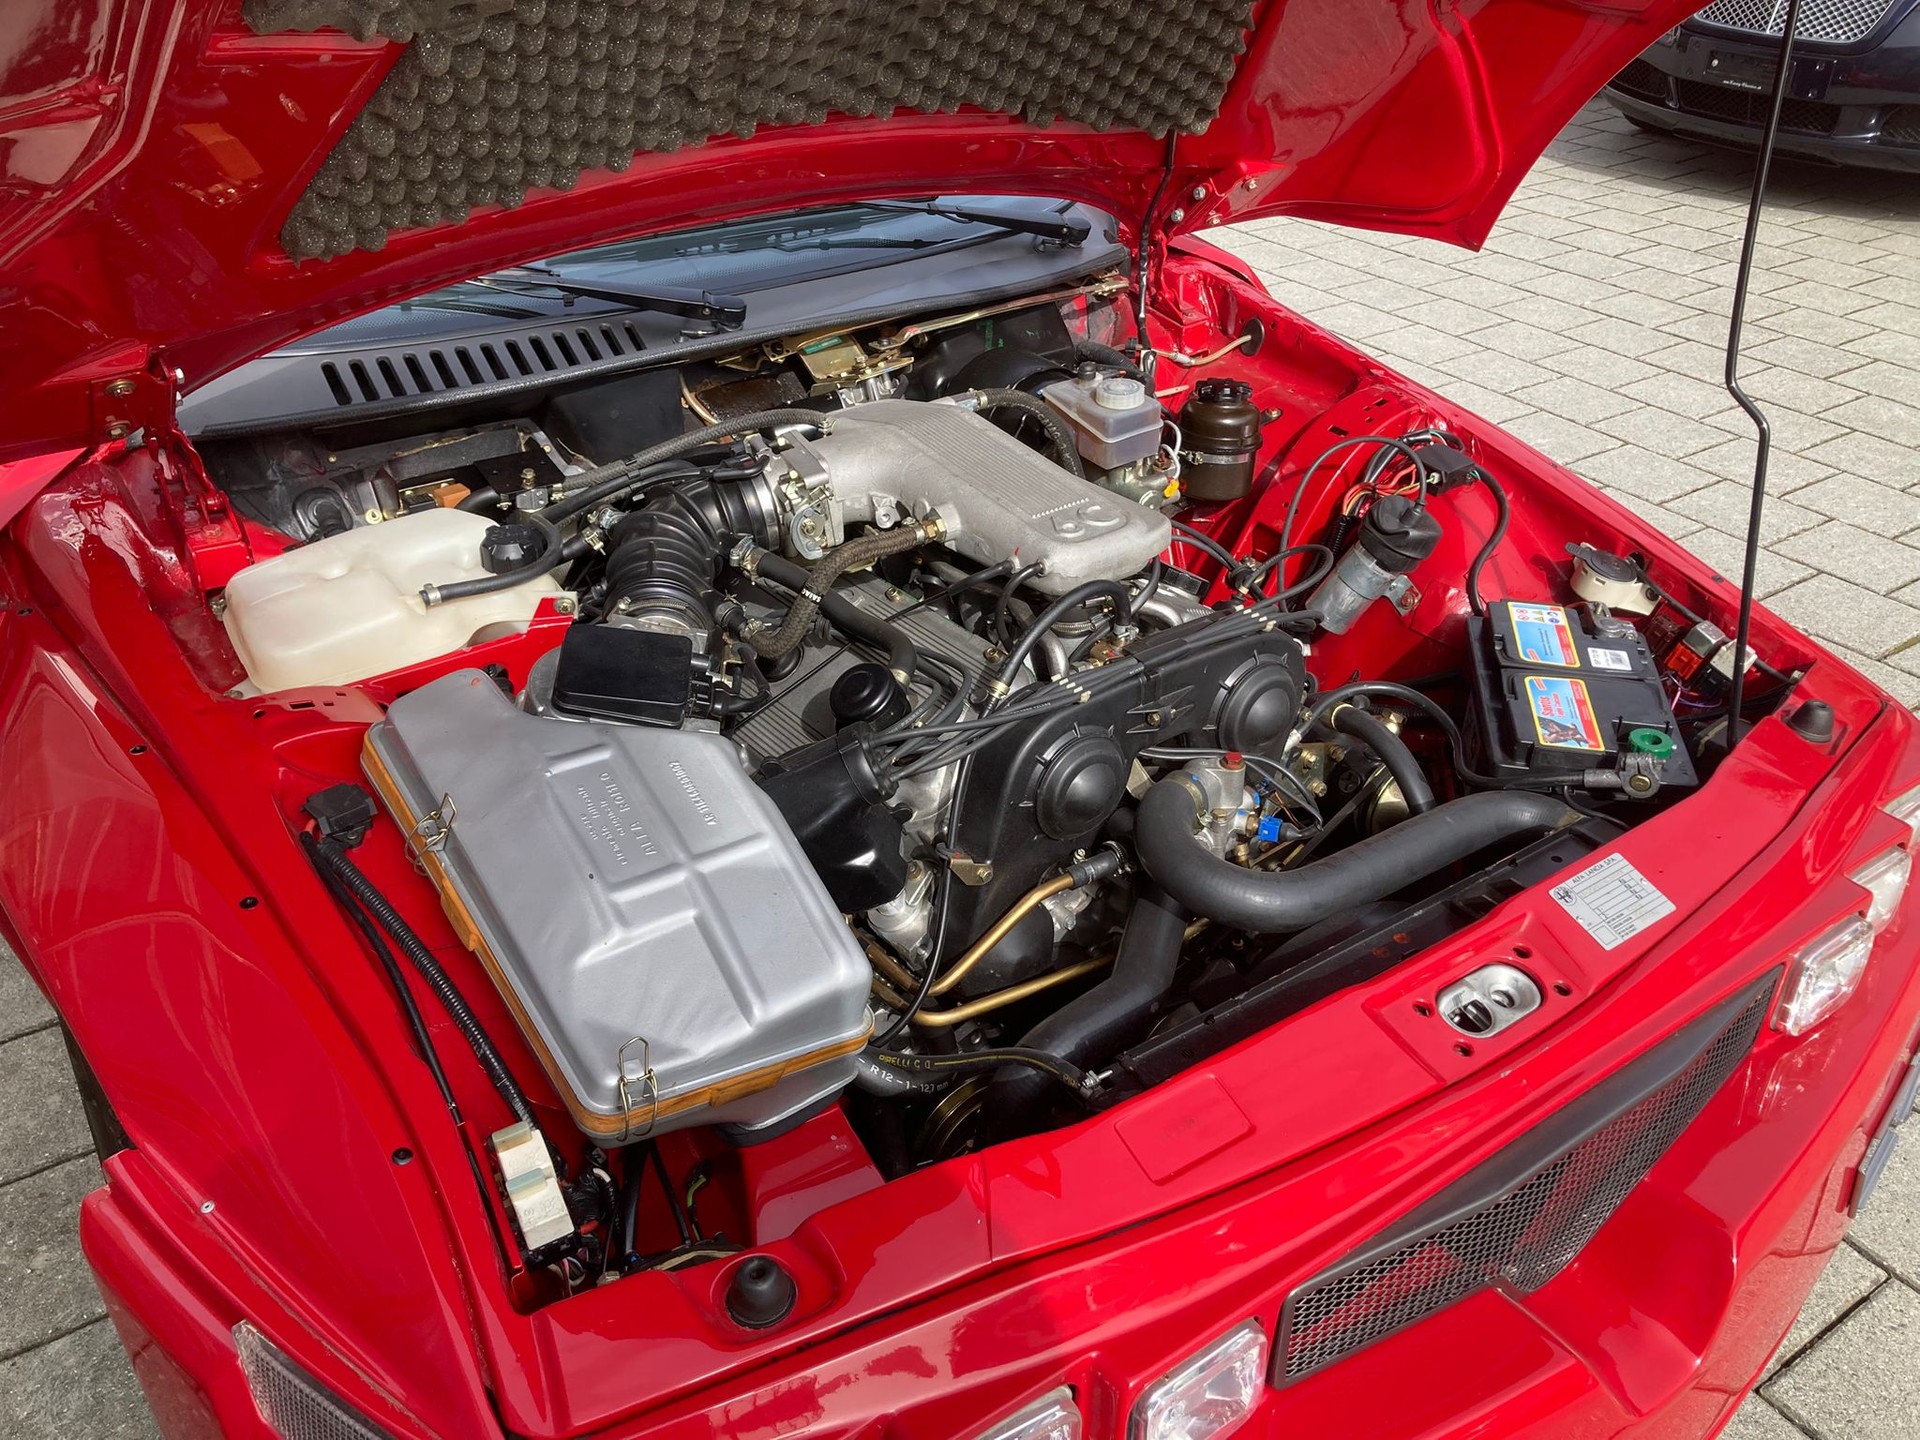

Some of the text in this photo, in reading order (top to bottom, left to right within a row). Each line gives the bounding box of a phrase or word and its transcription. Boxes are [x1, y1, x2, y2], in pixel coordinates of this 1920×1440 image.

[600, 772, 657, 855] ALFA ROMEO
[1571, 873, 1585, 884] ALFA
[1585, 863, 1604, 877] LANCIA
[879, 1055, 910, 1068] PIRELLI
